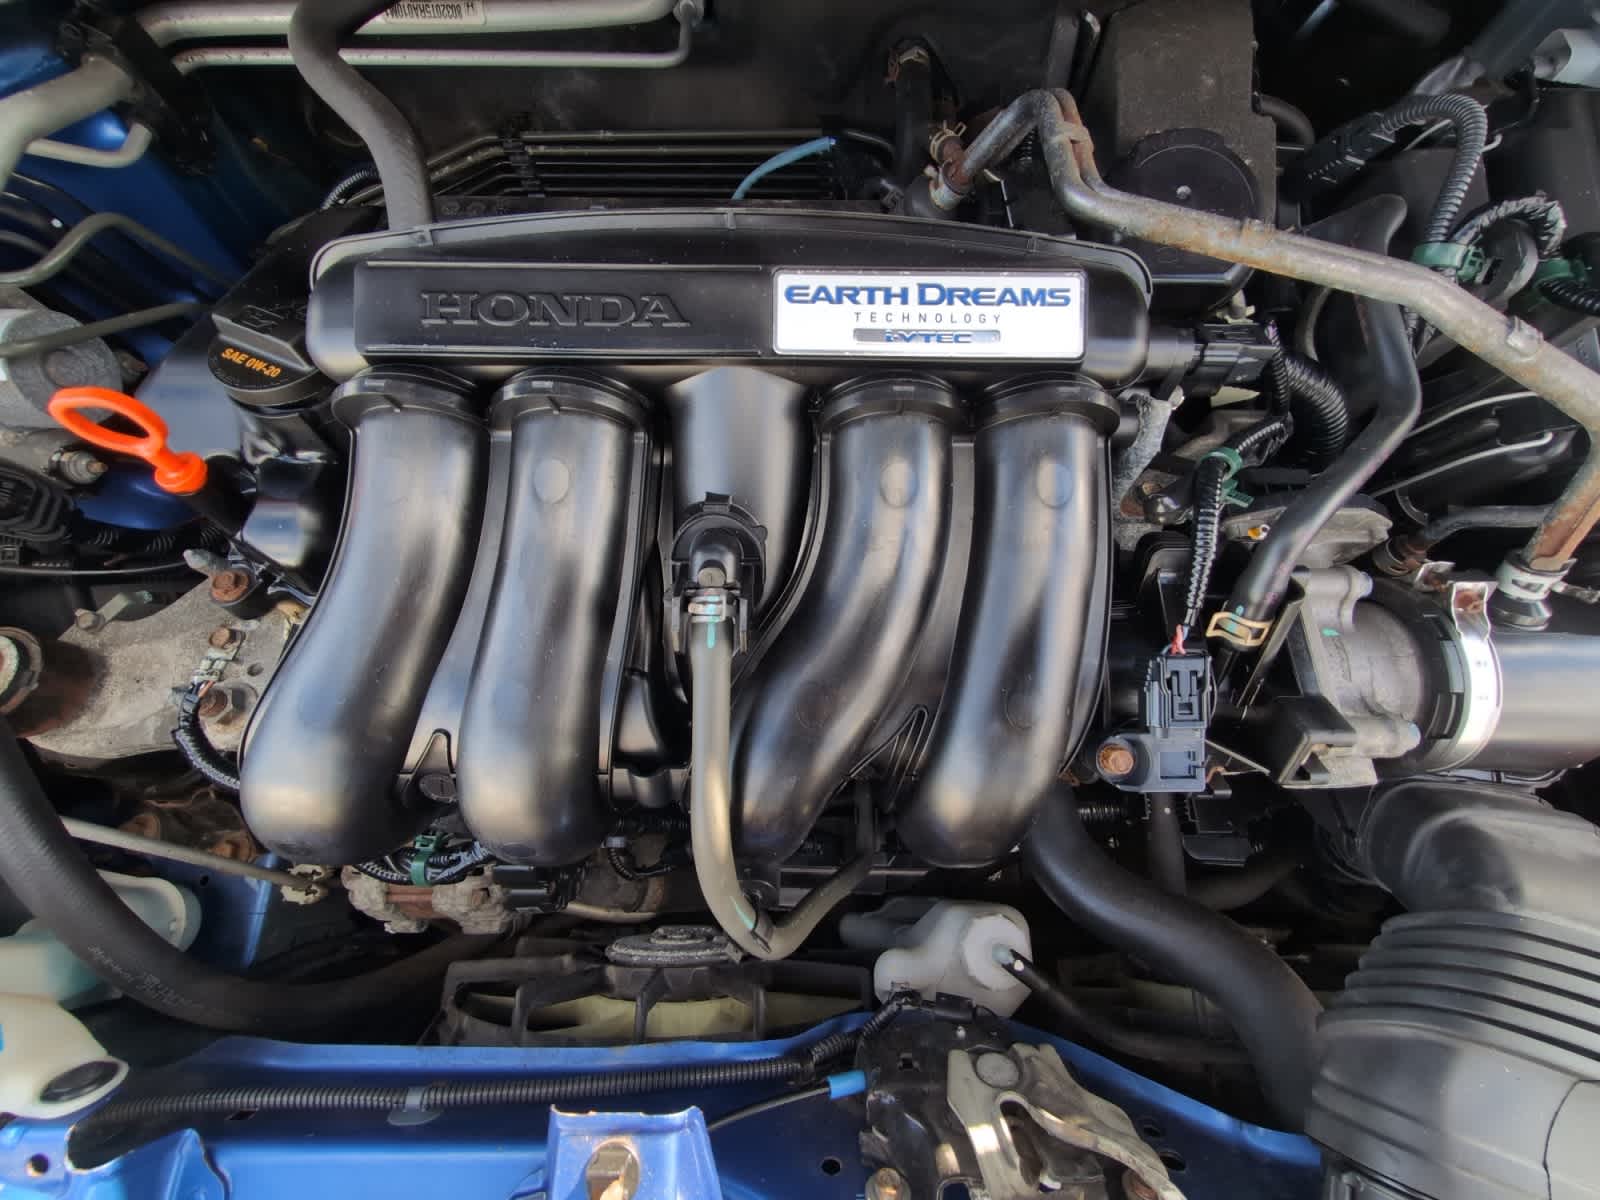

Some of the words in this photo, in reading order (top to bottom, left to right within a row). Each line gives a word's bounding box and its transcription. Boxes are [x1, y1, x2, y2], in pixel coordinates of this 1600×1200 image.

[784, 285, 909, 305] EARTH
[917, 282, 1071, 307] DREAMS
[420, 291, 691, 328] HONDA
[854, 311, 1001, 324] TECHNOLOGY
[221, 348, 249, 364] SAE
[245, 358, 282, 378] 0W-20
